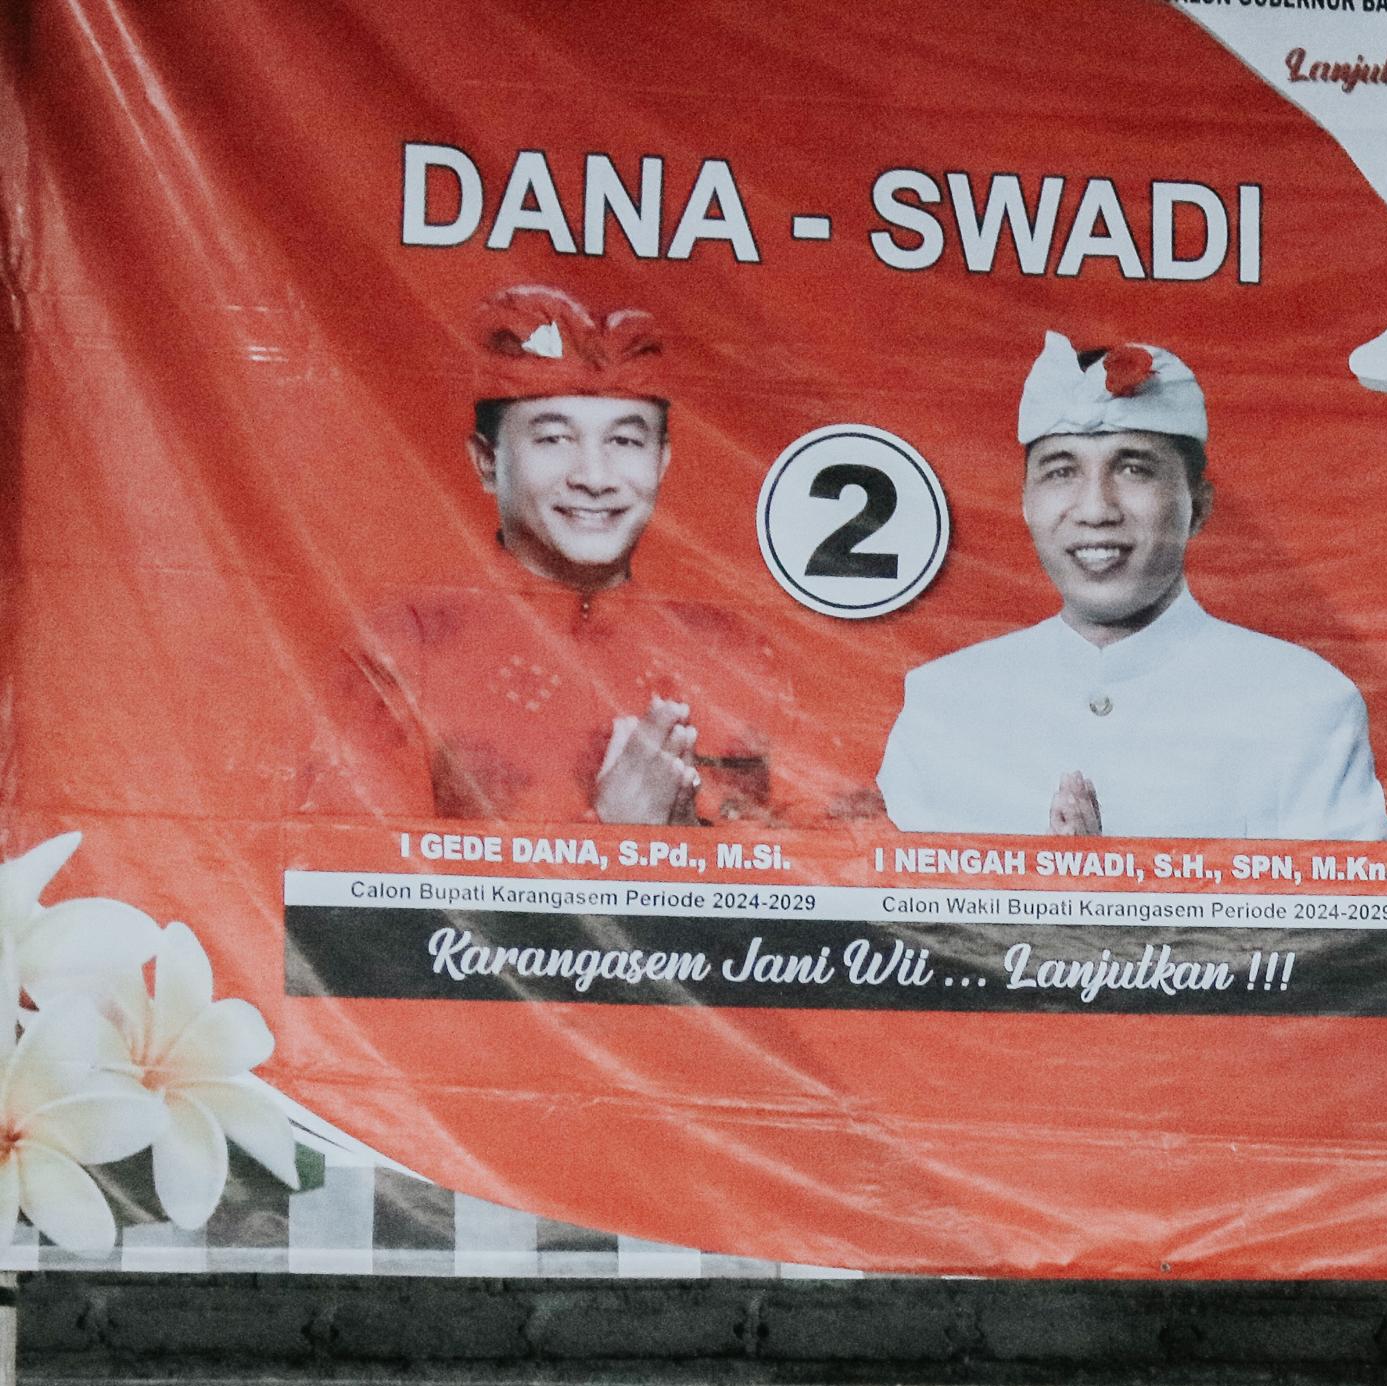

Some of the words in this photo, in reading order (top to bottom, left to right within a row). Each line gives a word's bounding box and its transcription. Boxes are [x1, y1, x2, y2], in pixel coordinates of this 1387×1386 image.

[401, 142, 761, 263] DANA
[870, 168, 1264, 285] SWADI
[804, 463, 899, 580] 2
[400, 833, 411, 858] I
[421, 833, 503, 863] GEDE
[512, 838, 609, 871] DANA,
[619, 840, 707, 874] S.Pd.,
[716, 843, 792, 871] M.Si.
[874, 846, 885, 871] I
[895, 848, 1026, 876] NENGAH
[1035, 851, 1145, 882] SWADI,
[1153, 854, 1223, 884] S.H.,
[1231, 856, 1303, 885] SPN,
[350, 880, 412, 901] Calon
[419, 882, 485, 905] Bupati
[492, 884, 618, 909] Karangasem
[625, 889, 706, 910] Periode
[712, 891, 817, 913] 2024-2029
[882, 895, 940, 916] Calon
[946, 897, 1001, 917] Wakil
[1007, 898, 1075, 921] Bupati
[1079, 899, 1205, 923] Karangasem
[1211, 901, 1288, 922] Periode
[428, 927, 711, 993] Karangasem
[721, 936, 836, 986] Jani
[843, 937, 935, 988] Wii
[1003, 942, 1237, 1004] Lanjutkan
[1246, 950, 1297, 992] !!!
